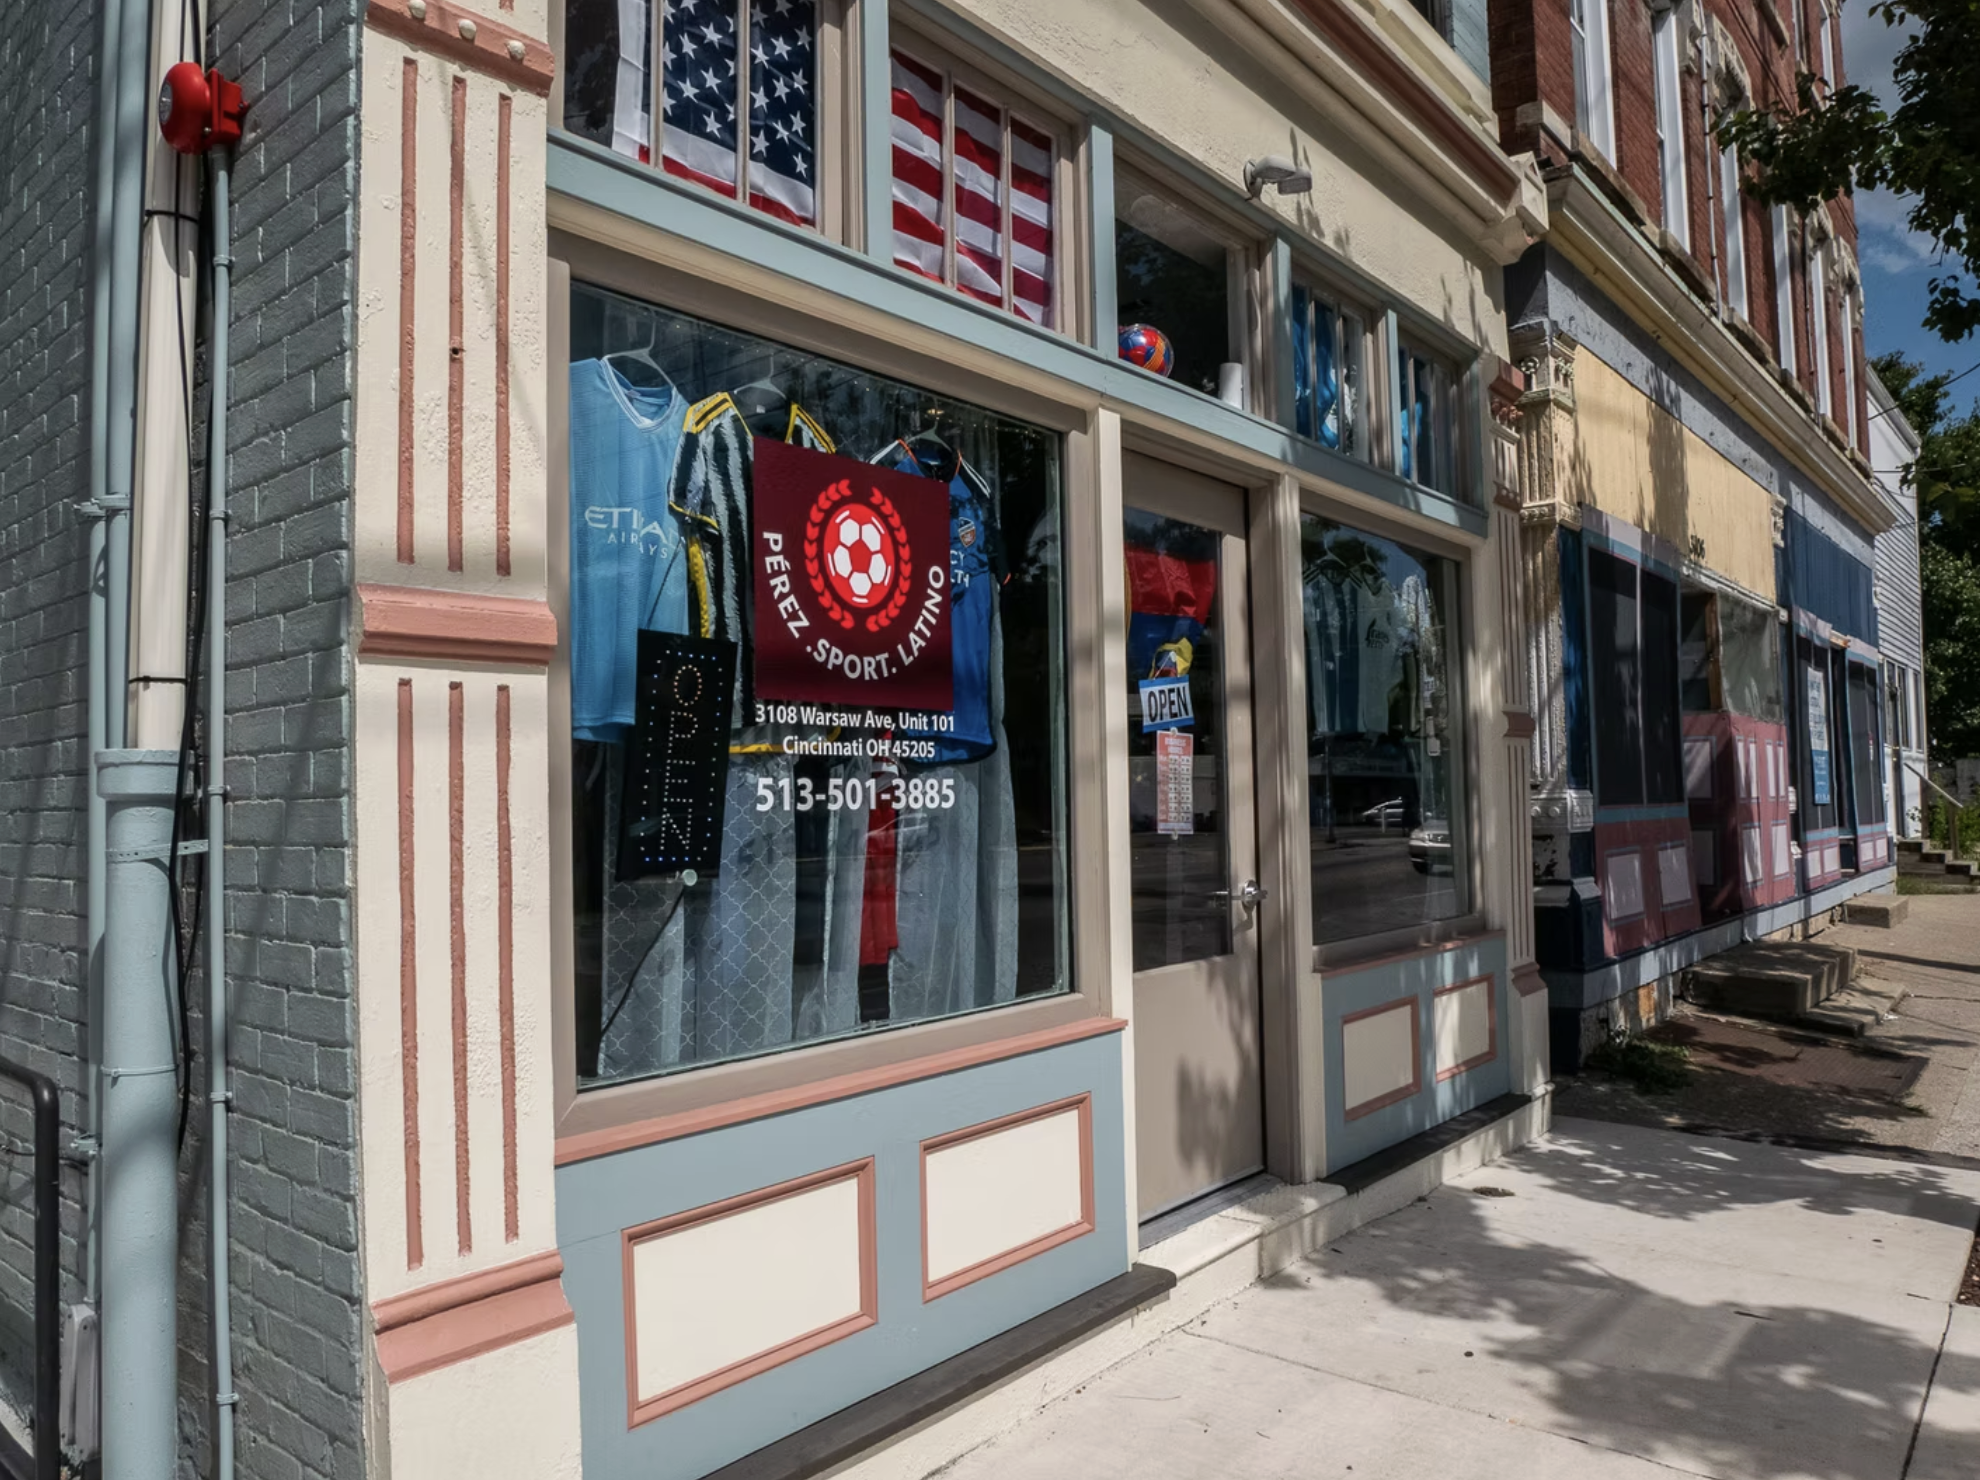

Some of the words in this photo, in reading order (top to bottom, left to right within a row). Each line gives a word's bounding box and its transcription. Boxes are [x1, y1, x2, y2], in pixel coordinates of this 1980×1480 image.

[897, 565, 945, 666] LATINO
[755, 705, 798, 724] 3108
[800, 706, 862, 729] Warsaw
[899, 712, 928, 731] Unit
[931, 715, 955, 733] 101
[1147, 686, 1189, 723] OPEN
[660, 664, 703, 850] OPEN
[782, 735, 863, 757] Cincinnati
[865, 738, 892, 757] OH
[892, 741, 936, 758] 45205
[755, 776, 956, 812] 513-501-3885
